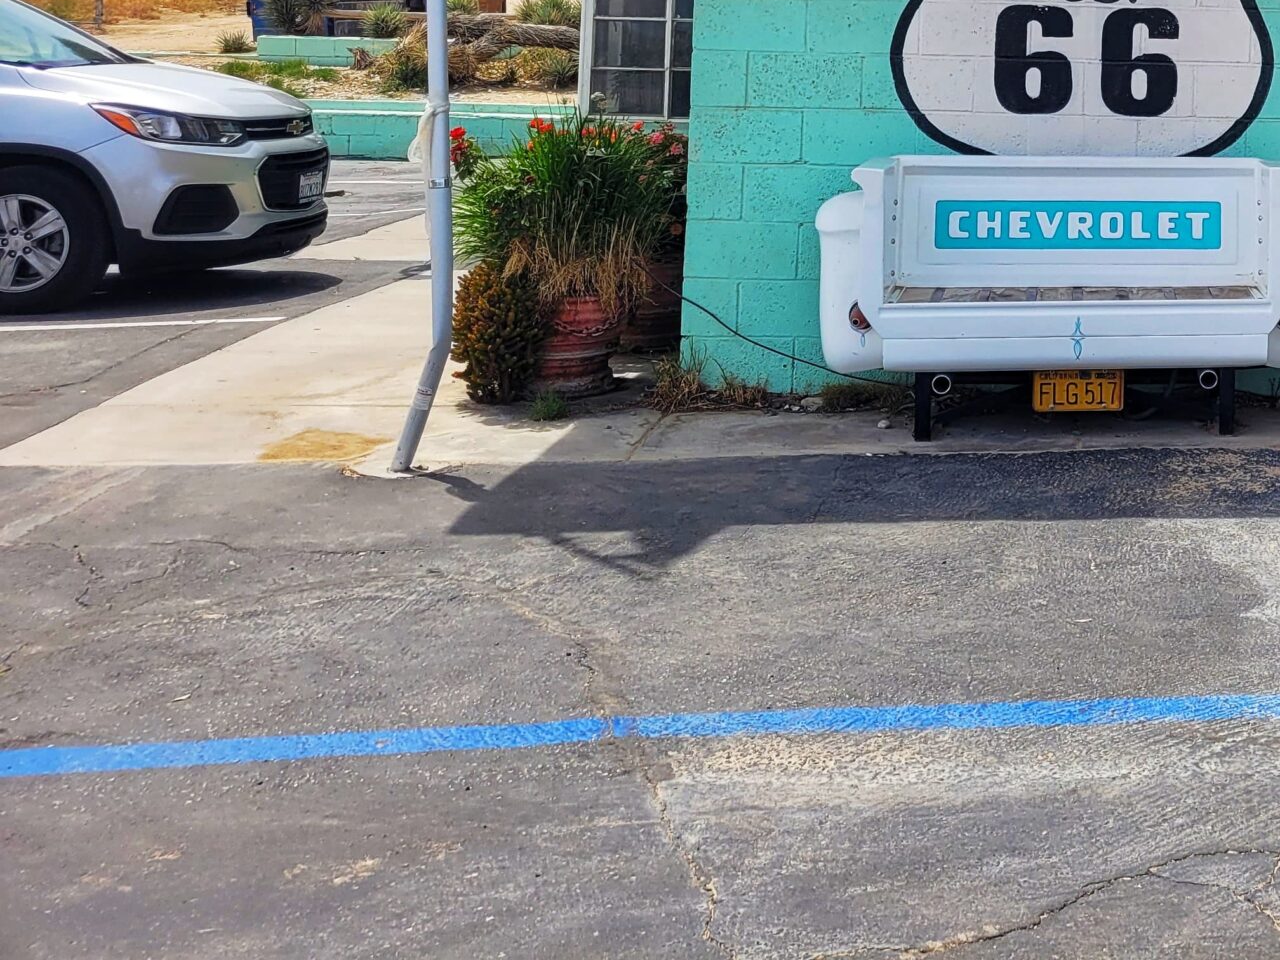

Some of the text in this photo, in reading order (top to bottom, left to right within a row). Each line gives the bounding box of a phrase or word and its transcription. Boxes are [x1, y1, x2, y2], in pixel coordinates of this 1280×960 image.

[994, 4, 1180, 117] 66
[948, 210, 1210, 240] CHEVROLET
[1039, 381, 1118, 406] FLG 517
